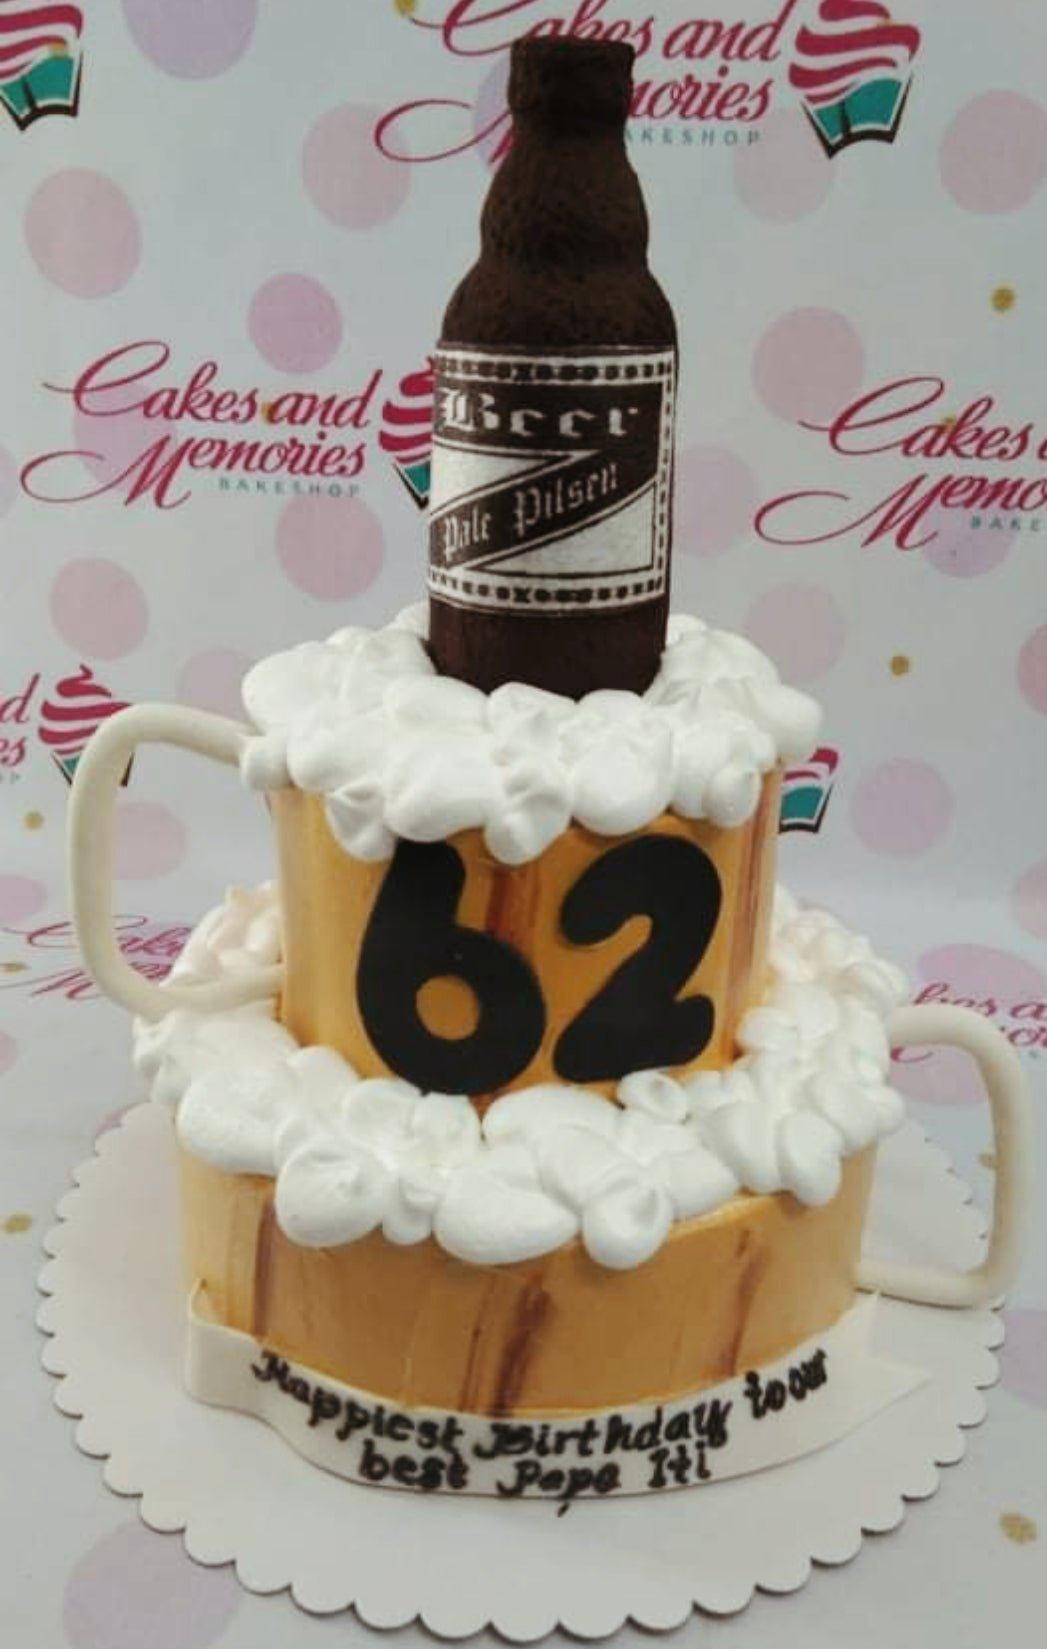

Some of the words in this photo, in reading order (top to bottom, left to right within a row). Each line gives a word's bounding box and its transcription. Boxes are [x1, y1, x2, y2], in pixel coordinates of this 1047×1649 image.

[662, 0, 797, 61] and
[42, 341, 259, 425] Cakes
[267, 369, 383, 428] and
[437, 387, 639, 437] Beer
[797, 376, 1035, 461] Cakes
[20, 431, 368, 509] Memories
[219, 477, 360, 497] BAKESHOP
[444, 505, 492, 563] Pale
[514, 463, 618, 538] Pilsen
[356, 833, 723, 1096] 62
[251, 1349, 465, 1450] Happiest
[473, 1400, 732, 1459] Birthday
[358, 1438, 470, 1490] best
